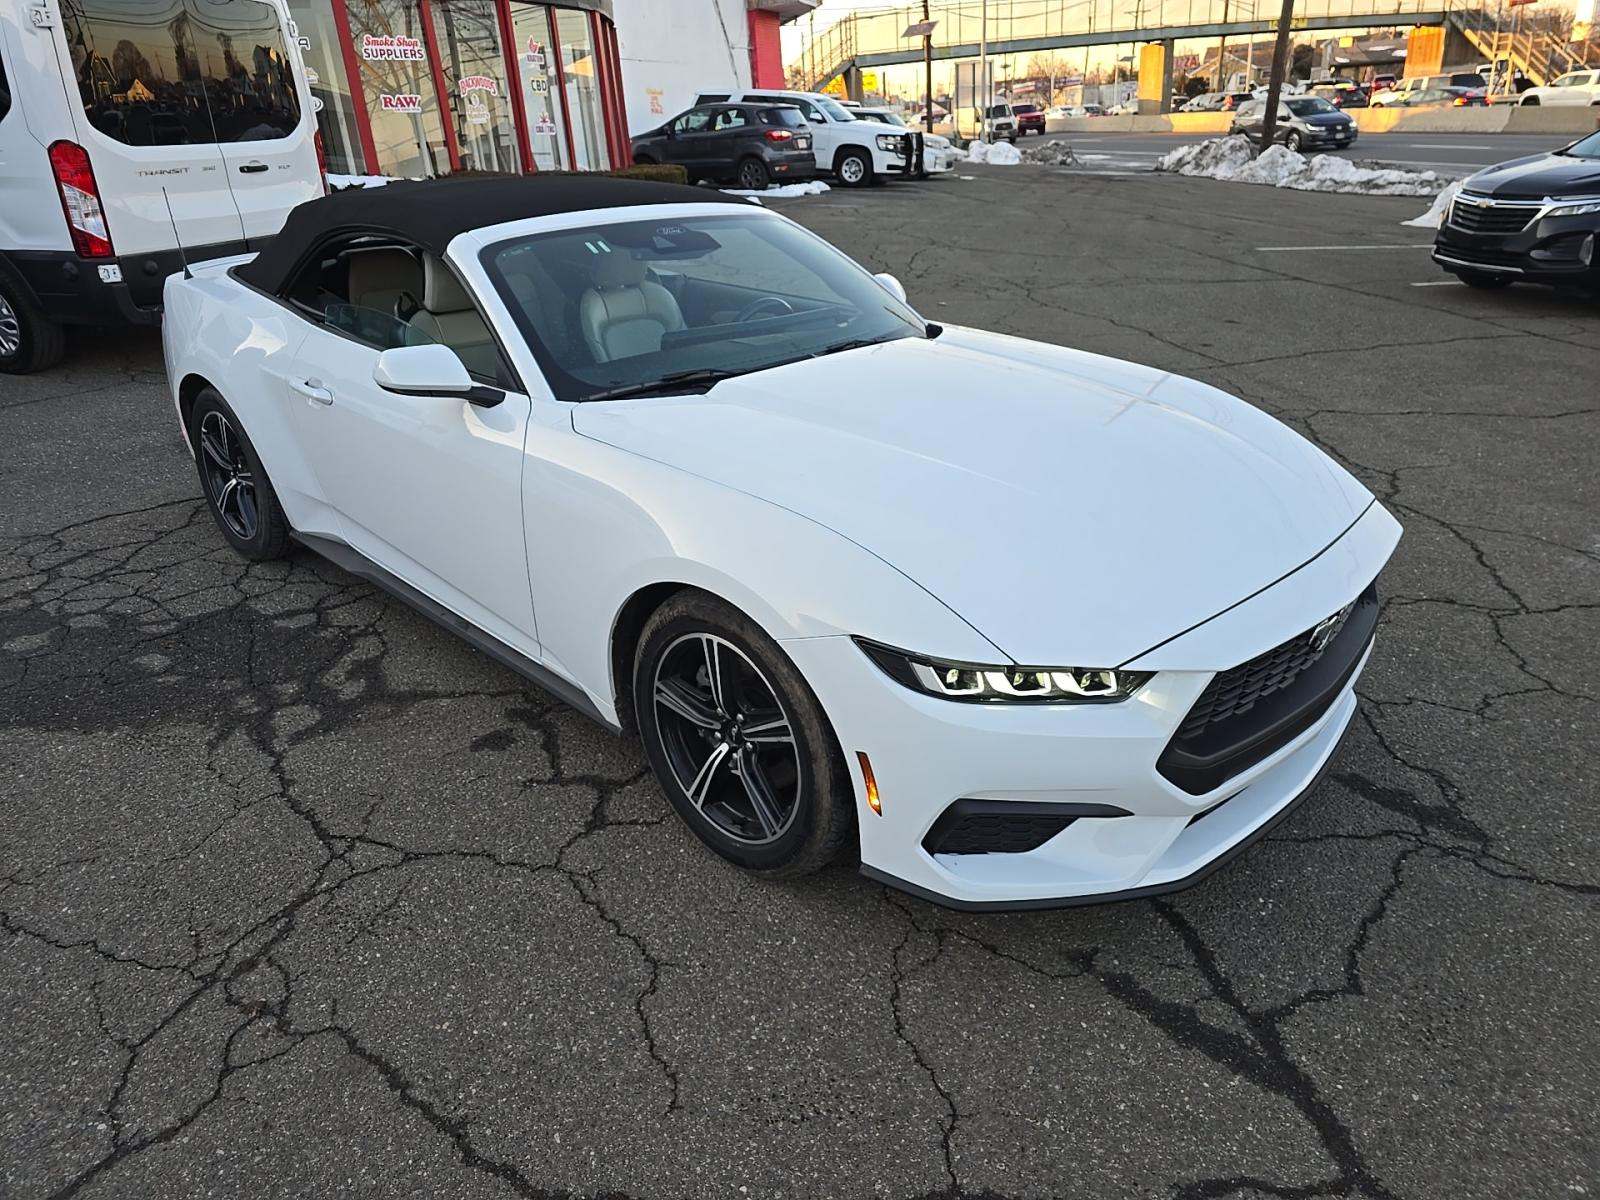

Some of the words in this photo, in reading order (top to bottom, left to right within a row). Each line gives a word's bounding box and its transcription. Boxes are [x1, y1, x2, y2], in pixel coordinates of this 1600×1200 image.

[364, 35, 395, 47] Smoke
[396, 36, 418, 49] Shop
[364, 48, 424, 59] SUPPLIERS
[460, 77, 497, 96] BACKWOODS
[531, 79, 547, 91] CBD
[382, 96, 418, 108] RAW
[138, 167, 190, 177] TRANSIT
